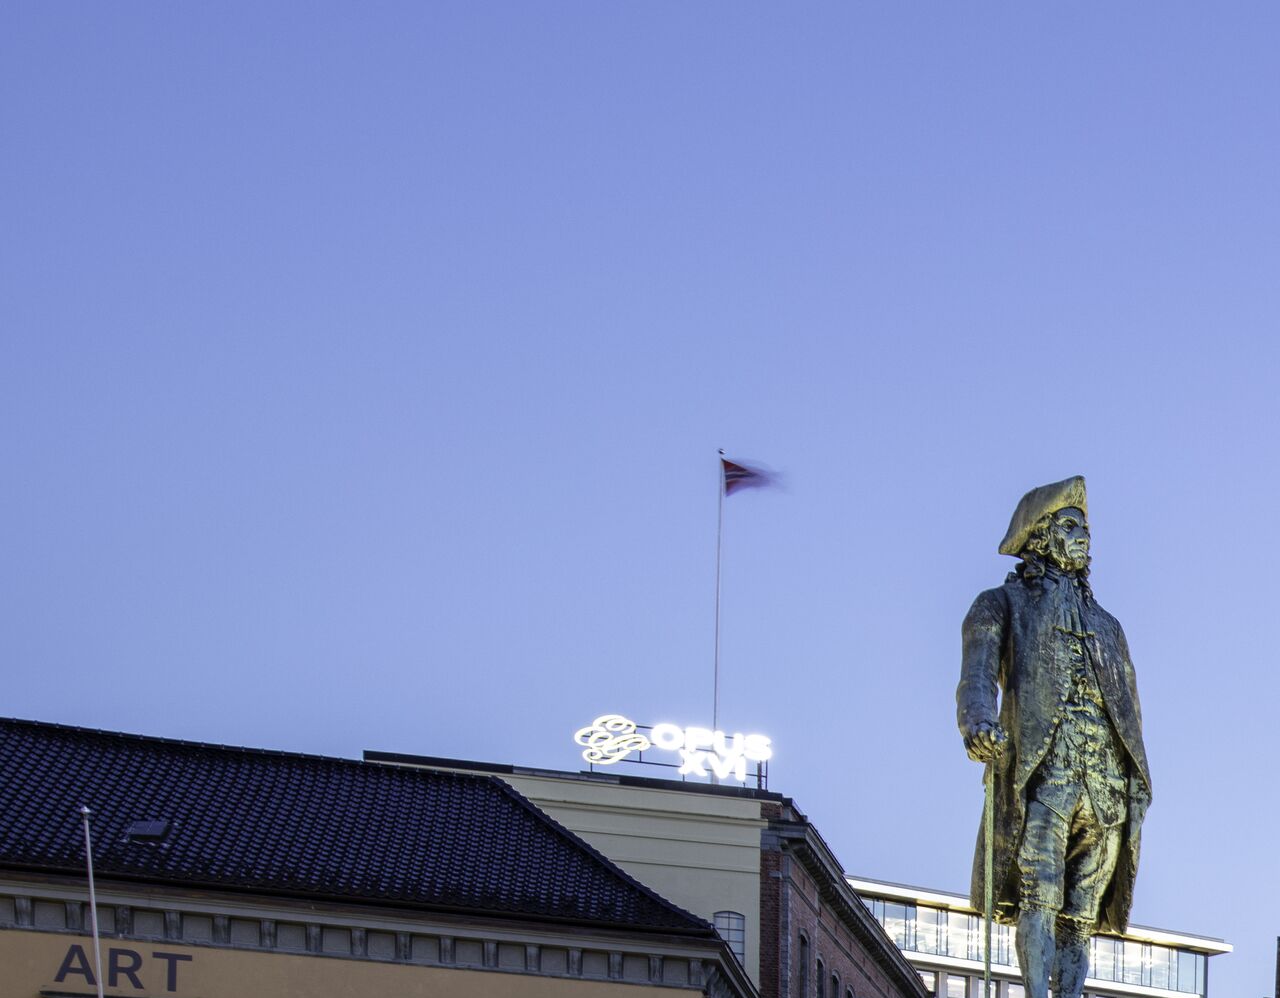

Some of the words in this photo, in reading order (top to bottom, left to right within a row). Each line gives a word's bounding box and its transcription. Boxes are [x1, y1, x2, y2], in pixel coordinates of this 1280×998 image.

[651, 723, 773, 761] OPUS
[678, 749, 746, 781] XVI
[54, 944, 193, 992] ART
